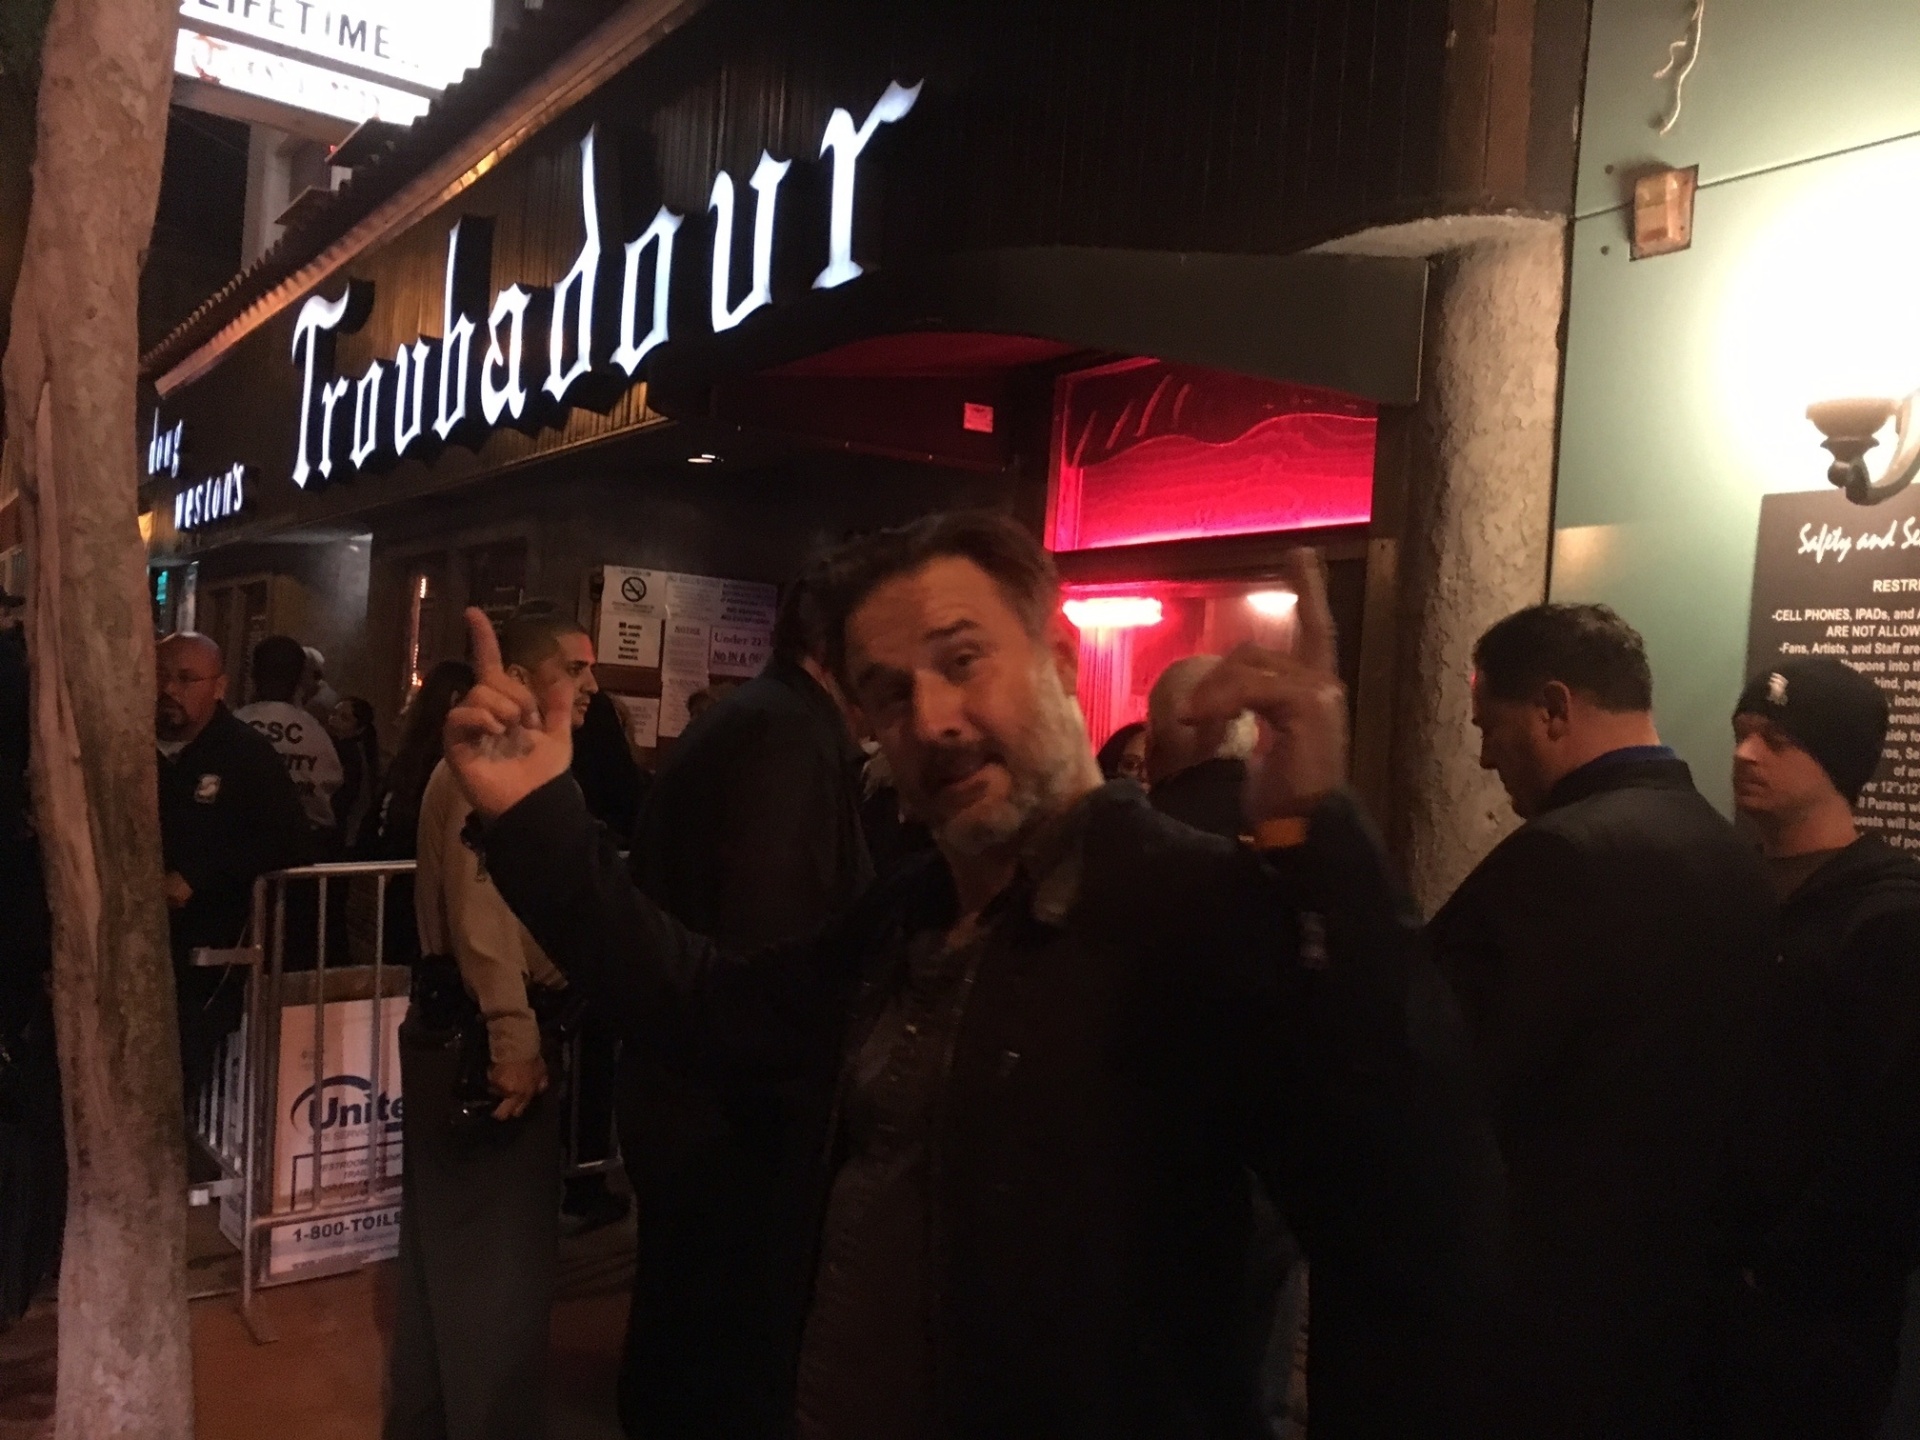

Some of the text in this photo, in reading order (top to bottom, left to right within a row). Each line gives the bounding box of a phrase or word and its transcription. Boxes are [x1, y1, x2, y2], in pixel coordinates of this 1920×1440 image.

[291, 79, 925, 489] Troubadour
[1798, 522, 1852, 563] Safety
[1856, 519, 1898, 550] and
[1804, 608, 1853, 622] PHONES,
[1855, 607, 1891, 621] IPADs,
[1893, 607, 1915, 620] and
[1826, 625, 1850, 637] ARE
[1852, 625, 1876, 637] NOT
[1812, 641, 1849, 655] Artists,
[1851, 641, 1873, 654] and
[1874, 642, 1901, 654] Staff
